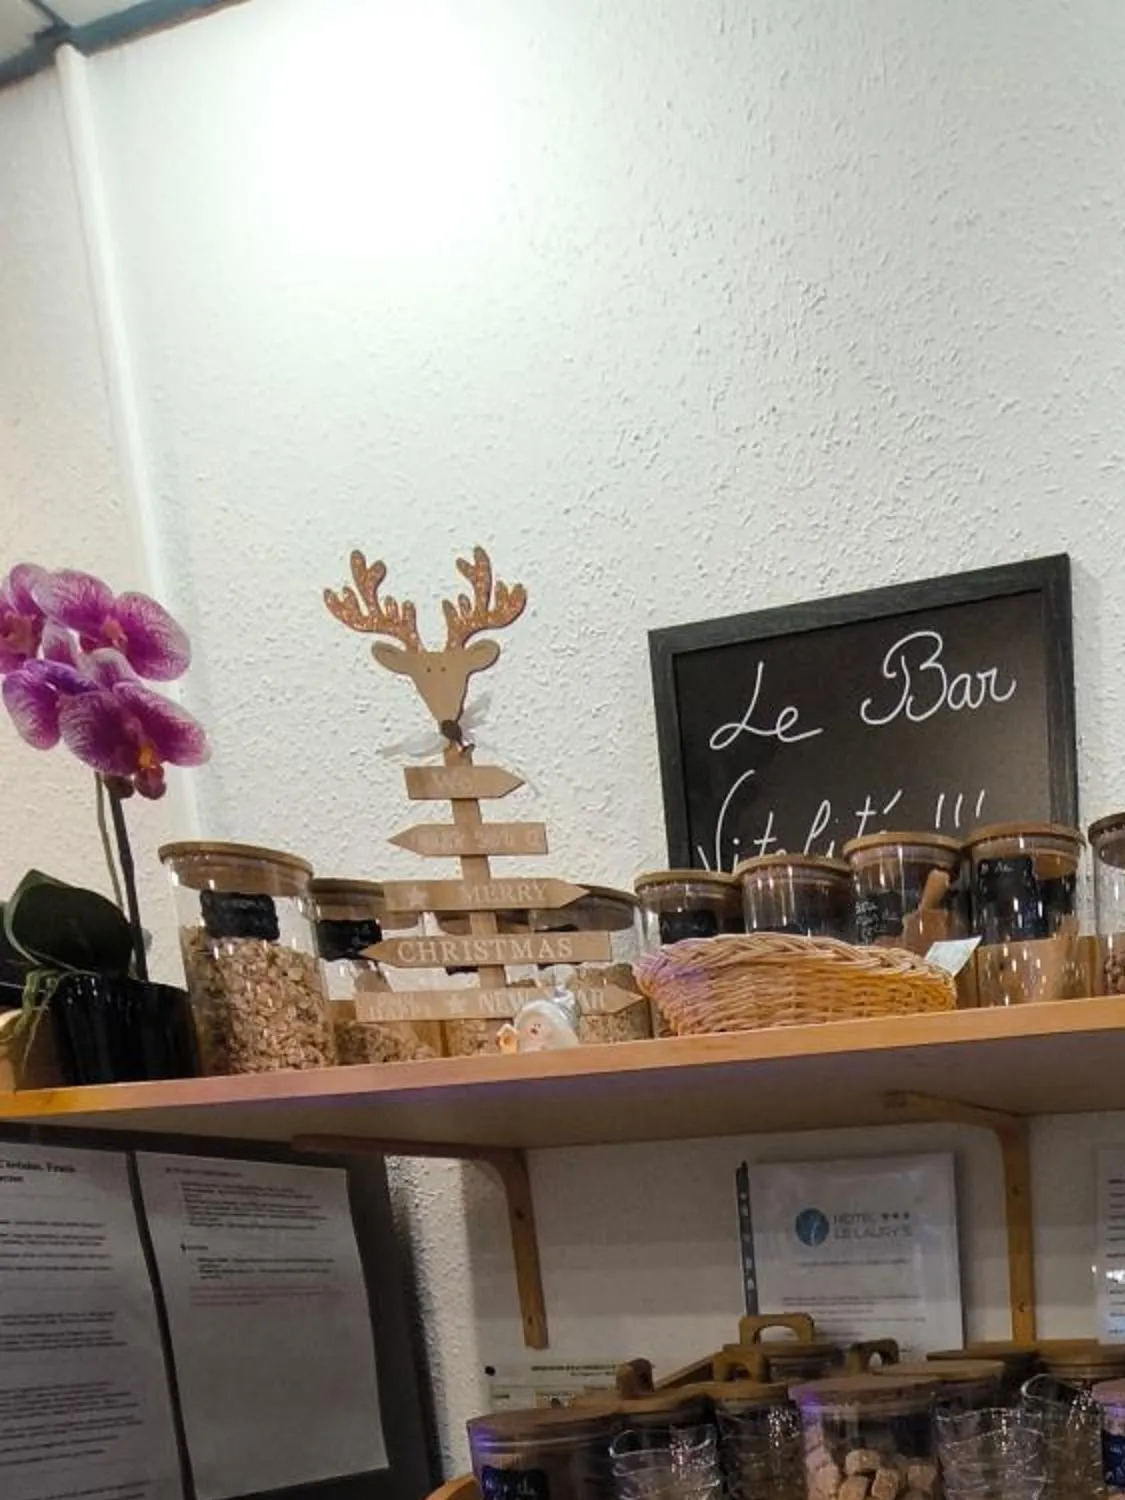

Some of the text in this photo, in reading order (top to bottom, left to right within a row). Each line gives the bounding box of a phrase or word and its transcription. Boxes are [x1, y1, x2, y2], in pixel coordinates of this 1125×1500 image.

[709, 630, 1017, 750] Le Bar
[459, 882, 550, 905] MERRY
[398, 937, 574, 963] CHRISTMAS
